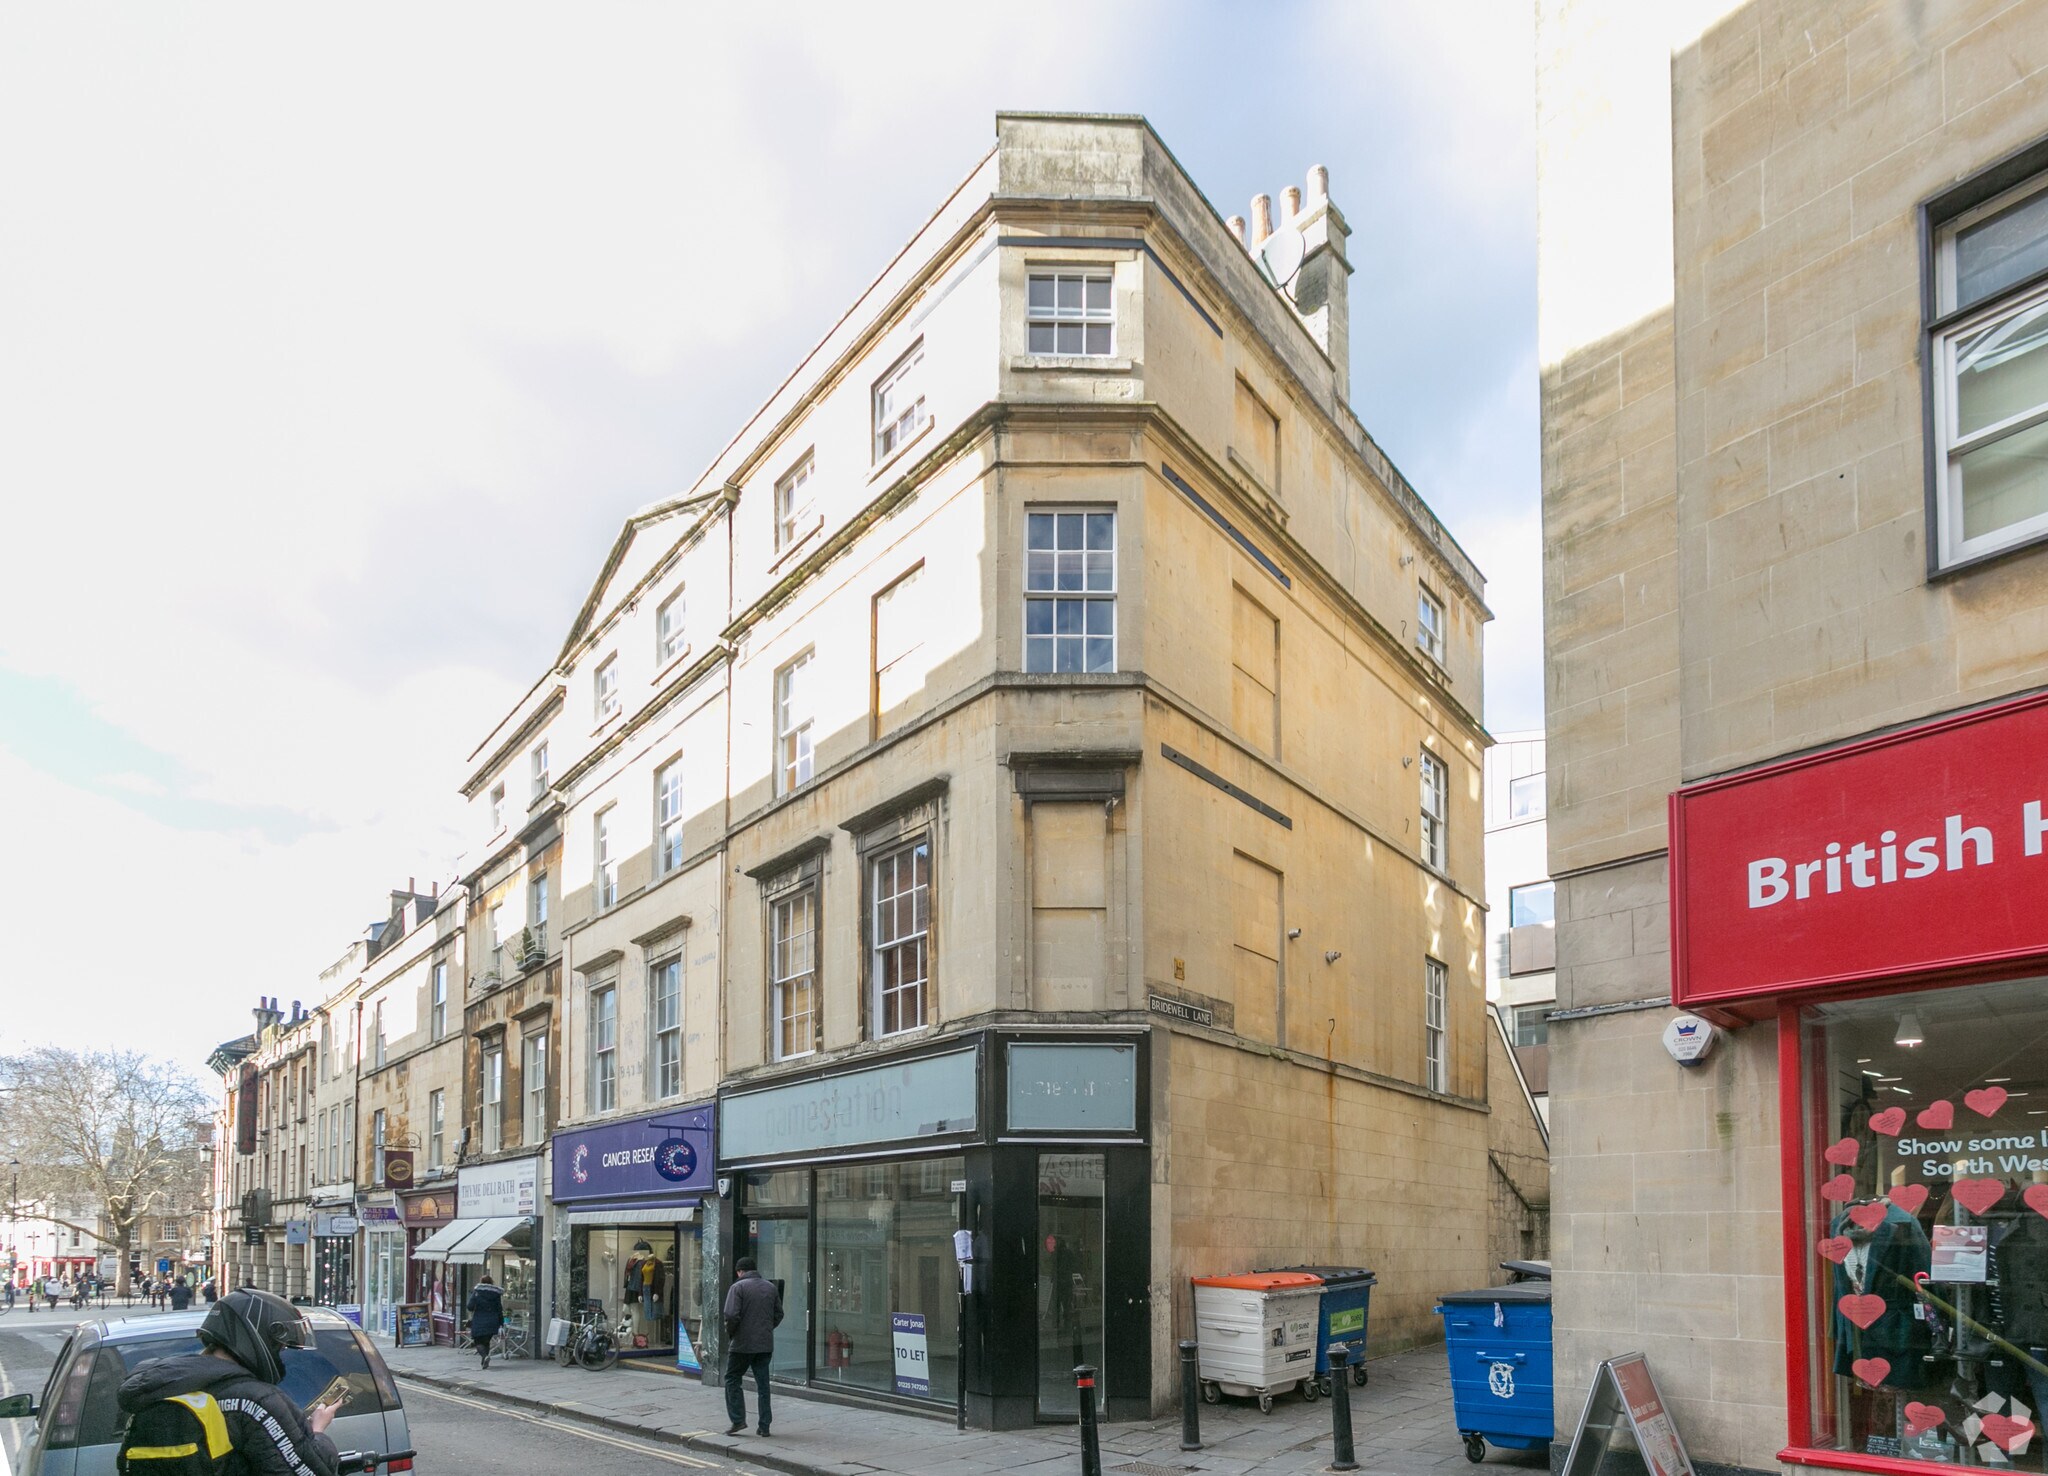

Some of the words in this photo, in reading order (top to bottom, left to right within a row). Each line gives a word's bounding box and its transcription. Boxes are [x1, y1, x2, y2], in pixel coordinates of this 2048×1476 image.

[1748, 814, 1994, 909] British
[1151, 999, 1190, 1019] BRIDEWELL
[1193, 1010, 1210, 1024] LANE
[765, 1083, 900, 1146] gamestation
[1897, 1138, 1962, 1156] Show
[1968, 1135, 2036, 1152] some
[602, 1150, 632, 1168] CANCER
[632, 1146, 659, 1164] RESEA
[1922, 1156, 1994, 1176] South
[461, 1184, 481, 1199] THYME
[483, 1181, 497, 1196] DELI
[497, 1179, 515, 1195] BATH
[893, 1317, 909, 1327] Carter
[910, 1319, 924, 1329] Jonas
[896, 1347, 907, 1359] TO
[910, 1349, 925, 1361] LET
[262, 1416, 286, 1442] HIGH
[276, 1436, 302, 1468] VALUE
